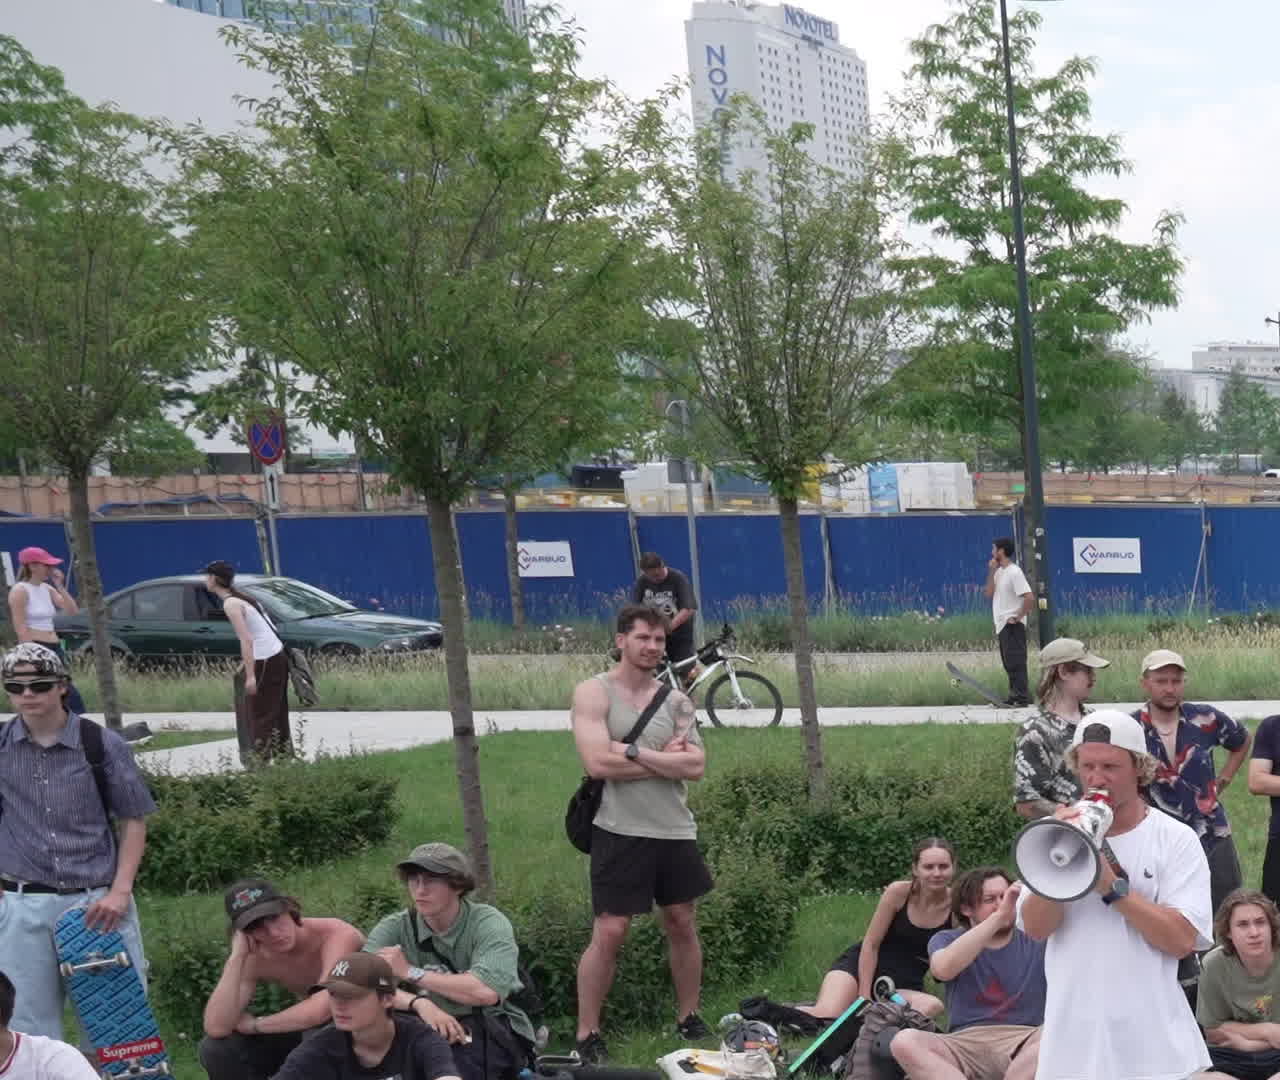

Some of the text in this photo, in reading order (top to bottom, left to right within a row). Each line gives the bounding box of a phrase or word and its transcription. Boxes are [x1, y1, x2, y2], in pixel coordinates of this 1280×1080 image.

[784, 4, 833, 39] NOVOTEL
[521, 555, 566, 563] WARBUD
[103, 1040, 159, 1060] Supreme
